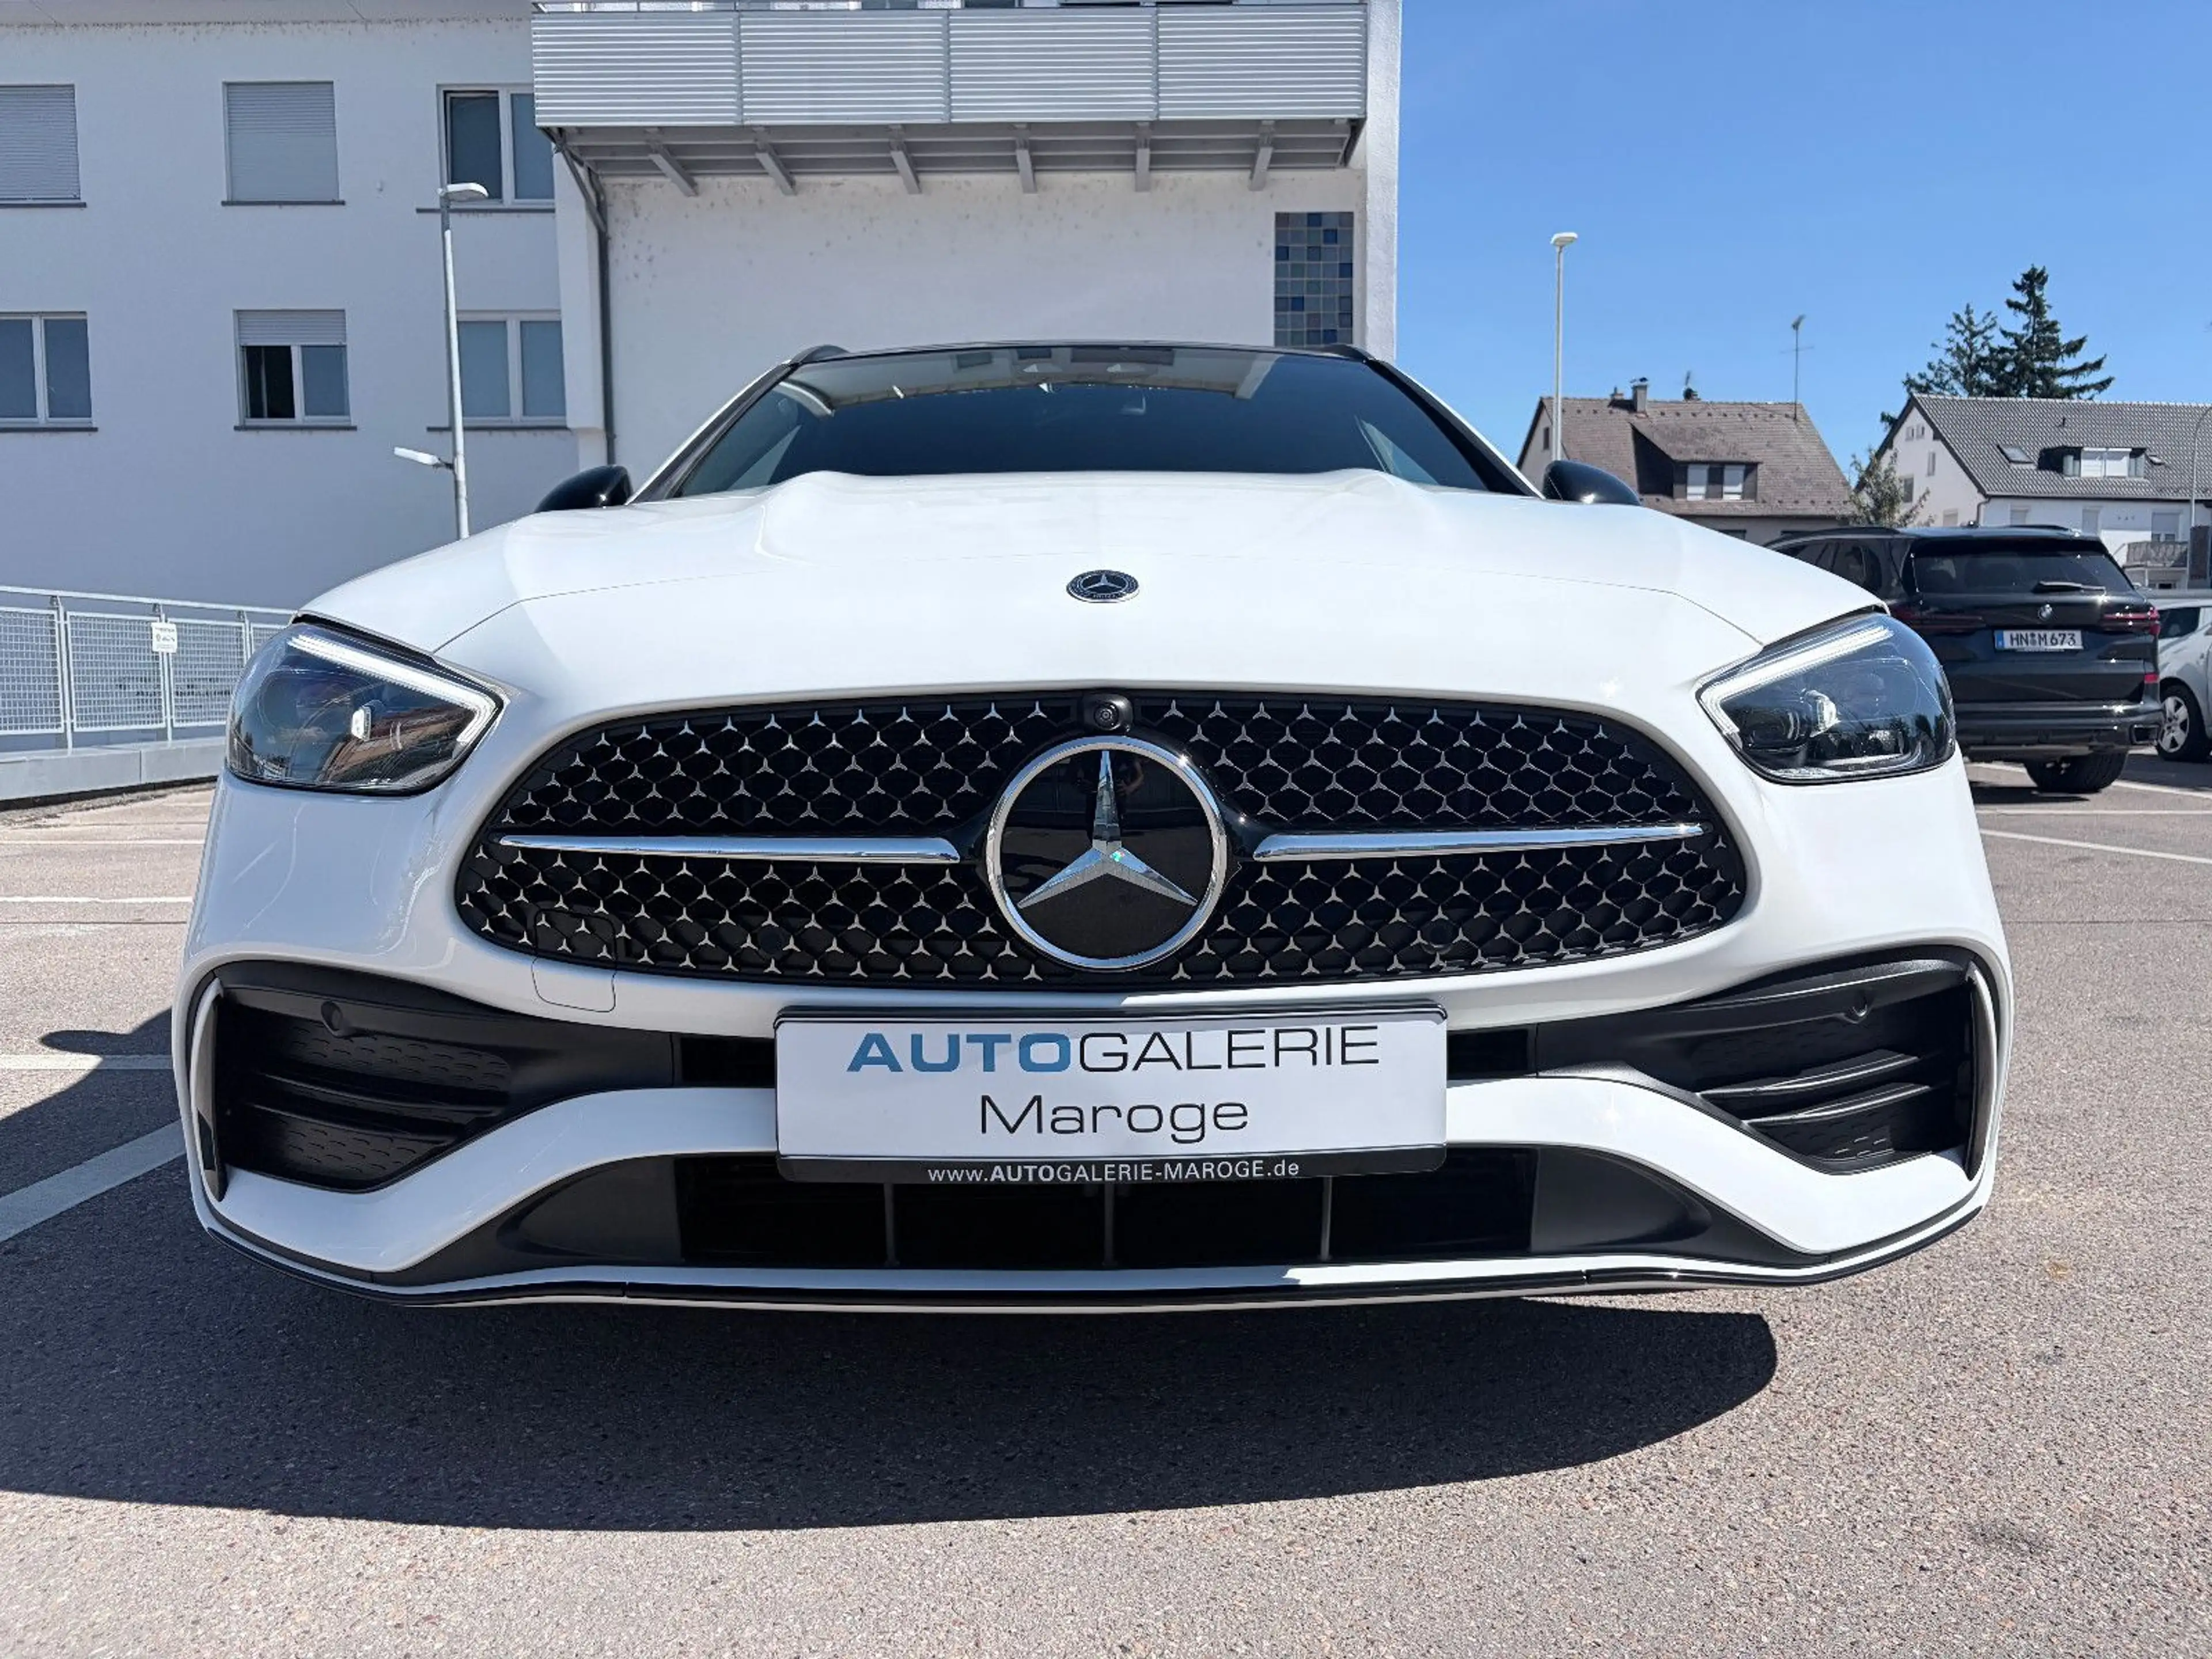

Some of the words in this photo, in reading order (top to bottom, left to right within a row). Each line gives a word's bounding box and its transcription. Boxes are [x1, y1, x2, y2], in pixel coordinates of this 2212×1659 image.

[2010, 633, 2029, 646] HN
[846, 1025, 1380, 1073] AUTOGALERIE
[980, 1094, 1249, 1145] Maroge
[927, 1159, 1300, 1182] www.AUTOGALERIE-MAROGE.de
